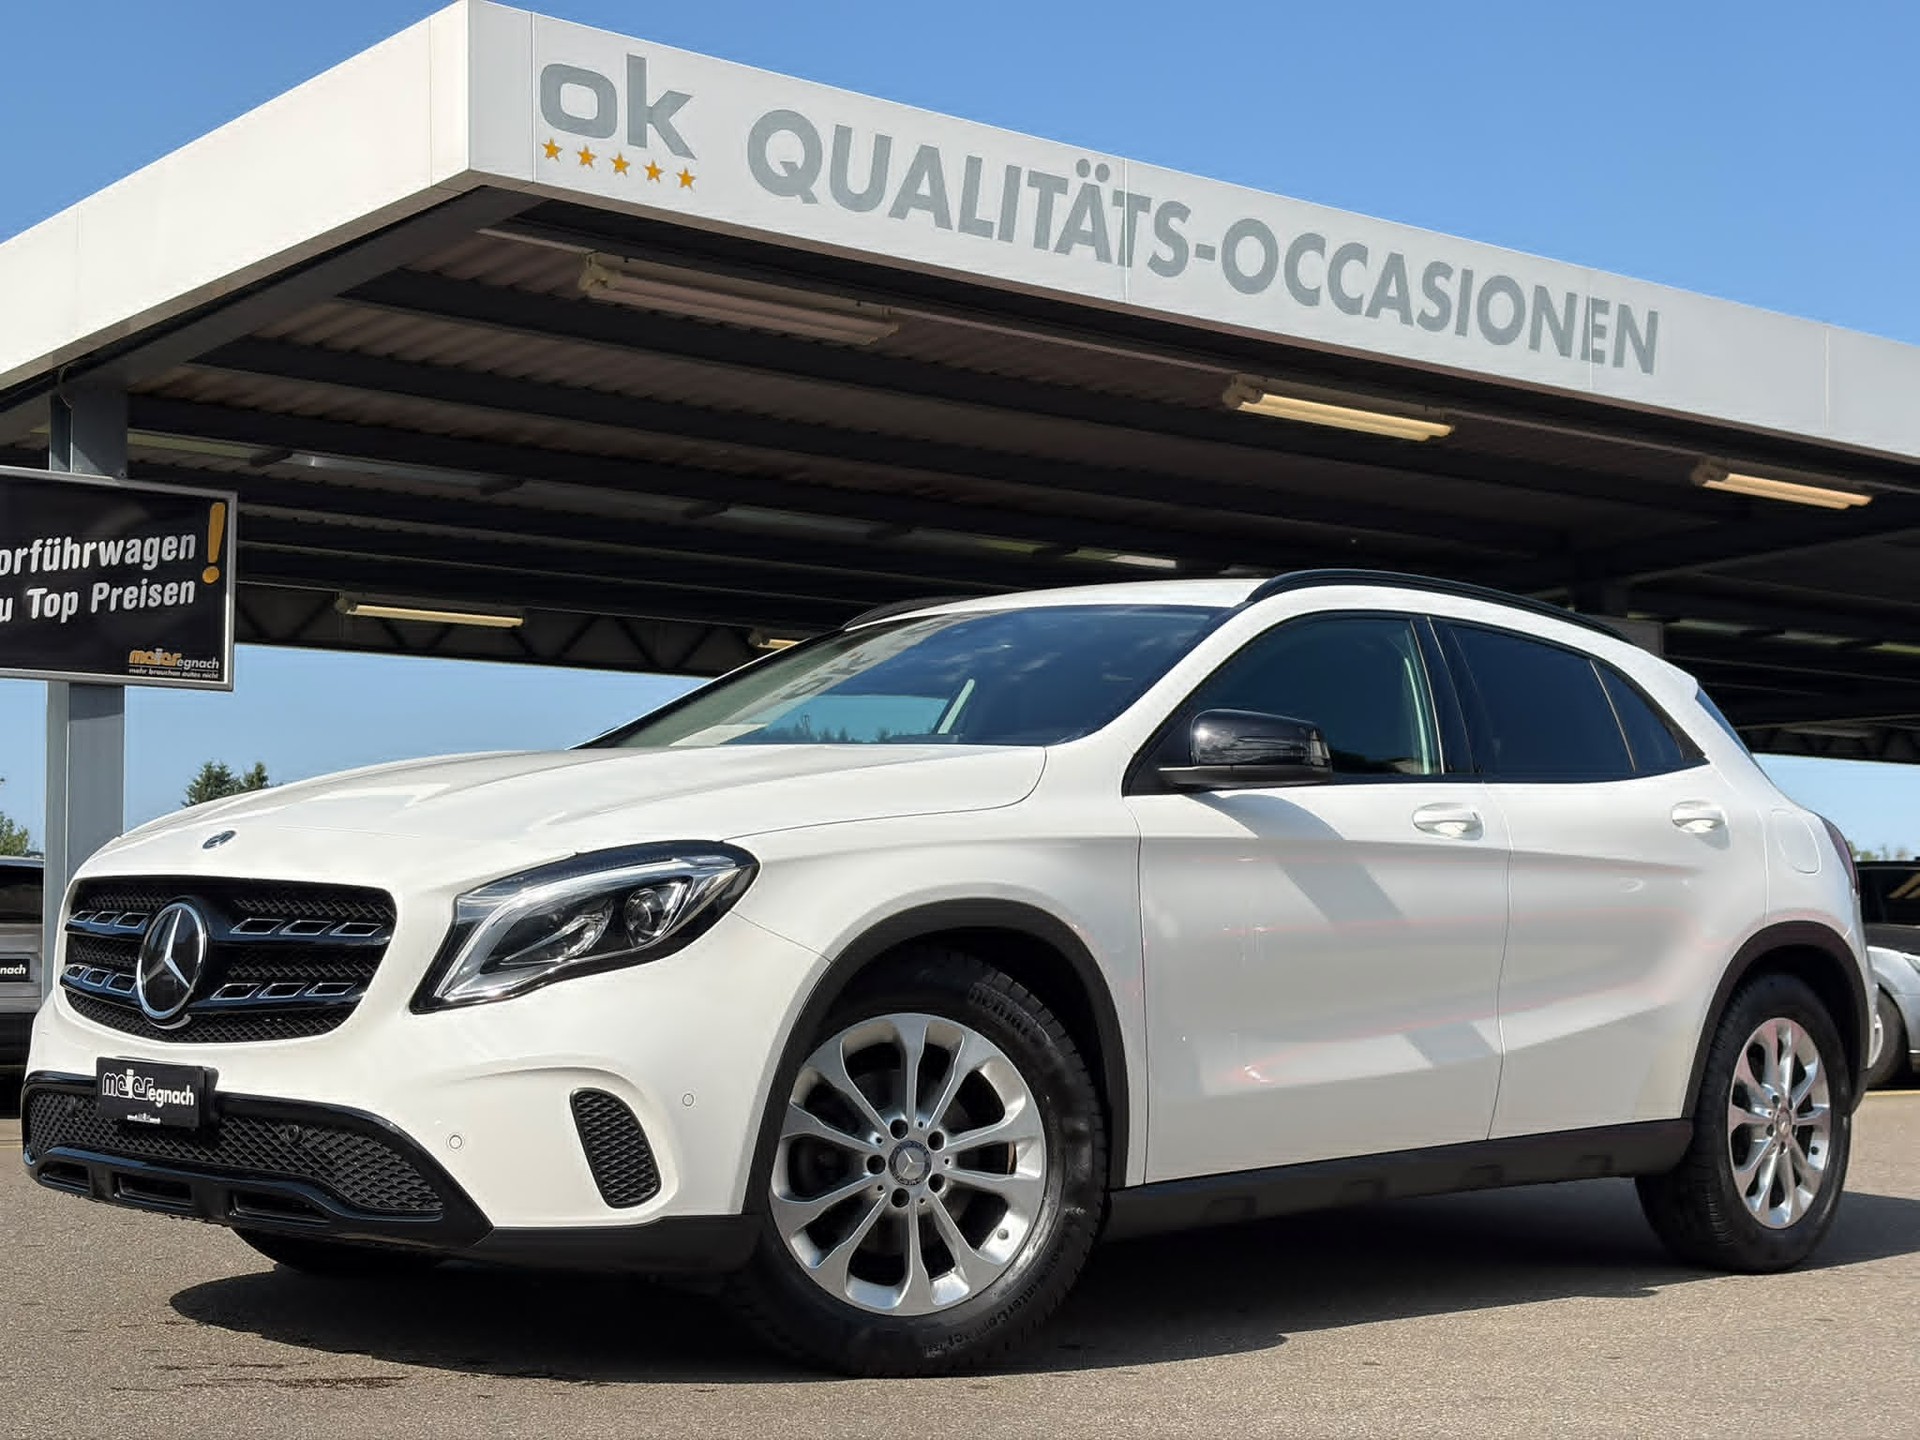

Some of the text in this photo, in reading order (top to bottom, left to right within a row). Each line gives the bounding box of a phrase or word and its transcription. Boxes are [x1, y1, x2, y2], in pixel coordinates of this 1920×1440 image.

[540, 53, 697, 160] ok
[747, 109, 1658, 375] QUALITÄTS-OCCASIONEN
[26, 587, 79, 623] Top
[90, 578, 196, 614] Preisen
[0, 965, 26, 975] nach
